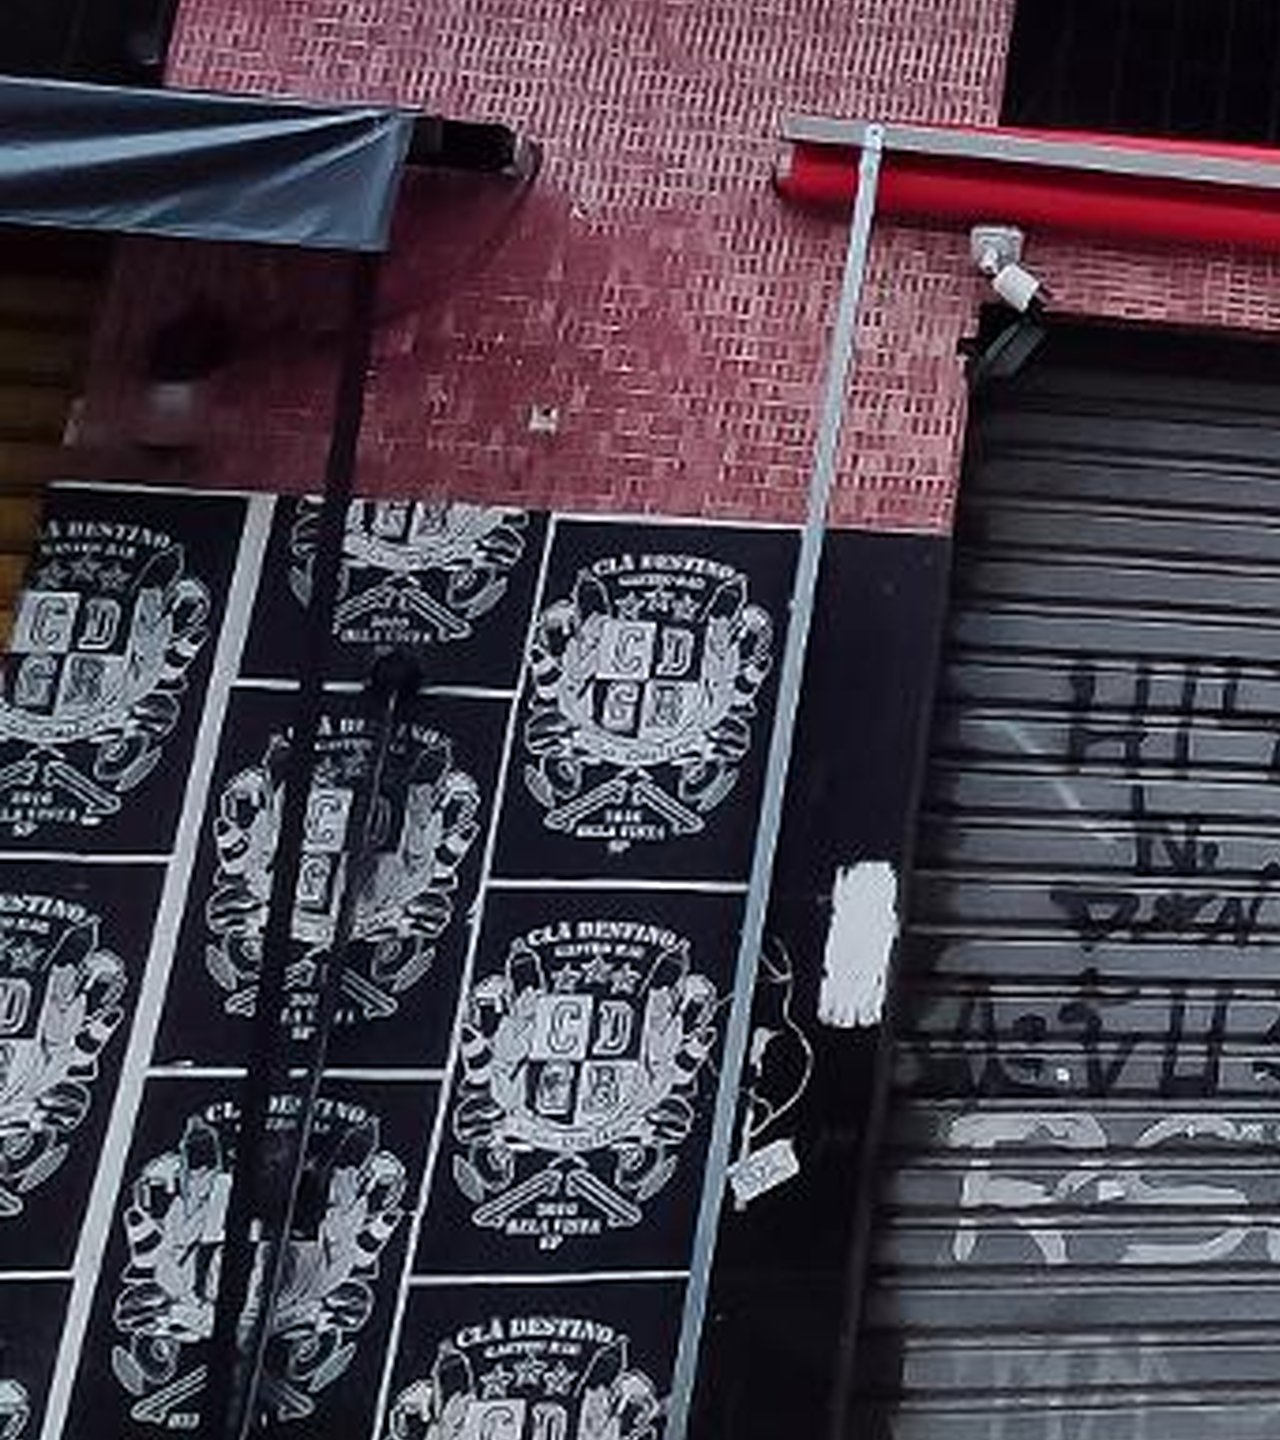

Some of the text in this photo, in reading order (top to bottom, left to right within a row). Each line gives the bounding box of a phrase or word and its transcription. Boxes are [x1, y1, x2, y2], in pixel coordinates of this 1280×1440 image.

[77, 598, 122, 649] D
[610, 626, 695, 676] C D
[577, 921, 677, 948] DESTINO
[549, 999, 634, 1056] C D
[509, 1318, 615, 1344] DESTINO
